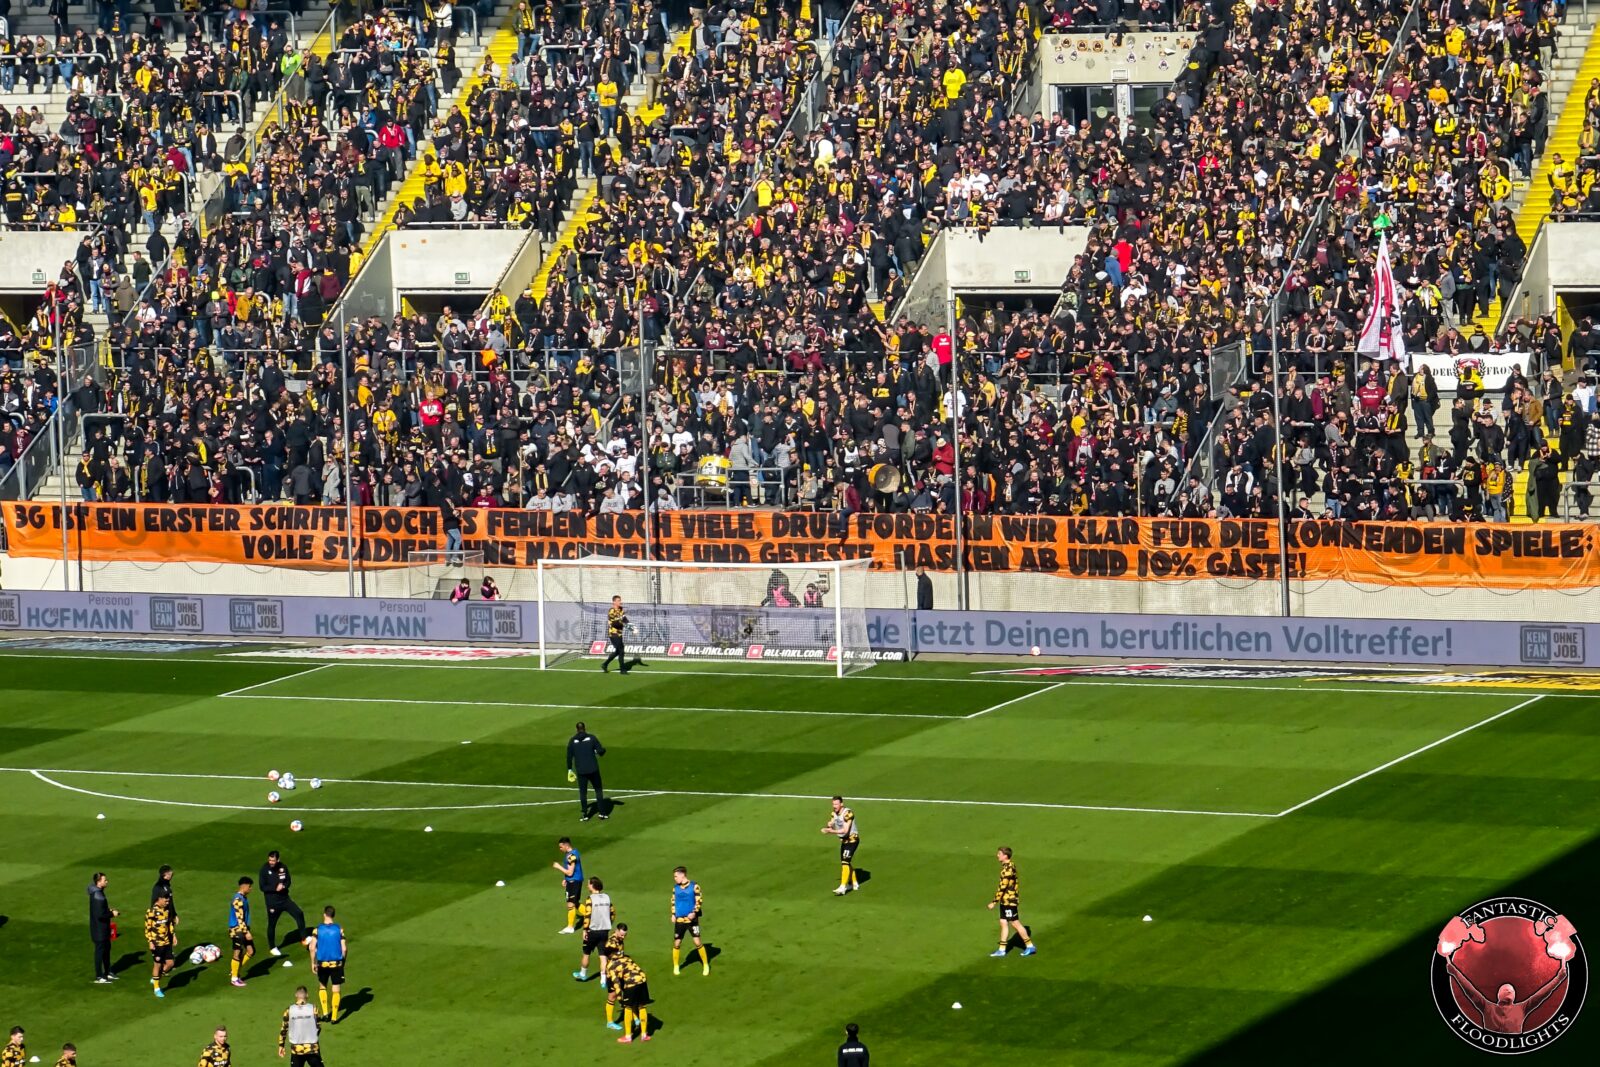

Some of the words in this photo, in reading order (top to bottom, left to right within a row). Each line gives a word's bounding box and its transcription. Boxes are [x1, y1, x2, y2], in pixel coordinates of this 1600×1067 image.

[14, 505, 46, 529] 3G
[52, 505, 89, 531] IST
[96, 508, 136, 531] EIN
[143, 508, 240, 532] ERSTER
[365, 509, 437, 535] DOCH
[488, 511, 587, 538] FEHLEN
[596, 512, 672, 539] NOCH
[681, 513, 763, 540] VIELE,
[857, 514, 994, 541] FORDERN
[1001, 516, 1057, 543] WIR
[1067, 518, 1140, 545] KLAR
[1220, 520, 1269, 549] DIE
[1279, 520, 1465, 554] KOMMENDEN
[1475, 528, 1593, 558] SPIELE:
[242, 535, 313, 559] VOLLE
[323, 536, 437, 562] STADIEN
[463, 540, 516, 565] HNE
[693, 543, 750, 563] UND
[893, 543, 1009, 571] MASKEN
[1019, 547, 1060, 572] AB
[1068, 548, 1128, 576] UND
[1138, 549, 1197, 577] 10%
[0, 599, 15, 608] HNE
[88, 594, 133, 606] Personal
[154, 601, 173, 613] KEIN
[177, 603, 197, 613] OHNE
[234, 604, 252, 615] KEIN
[257, 604, 278, 615] OHNE
[379, 601, 426, 613] Personal
[0, 609, 17, 621] OB.
[27, 607, 133, 629] HOFMANN
[471, 608, 490, 619] KEIN
[495, 609, 516, 620] OHNE
[155, 613, 173, 627] FAN
[235, 615, 252, 628] FAN
[315, 614, 426, 637] HOFMANN
[471, 620, 490, 634] FAN
[911, 616, 974, 650] jetzt
[985, 619, 1089, 648] Deinen
[1101, 620, 1272, 652] beruflichen
[1282, 624, 1452, 656] Volltreffer!
[1526, 631, 1548, 643] KEIN
[1553, 632, 1578, 644] OHNE
[1527, 644, 1548, 657] FAN
